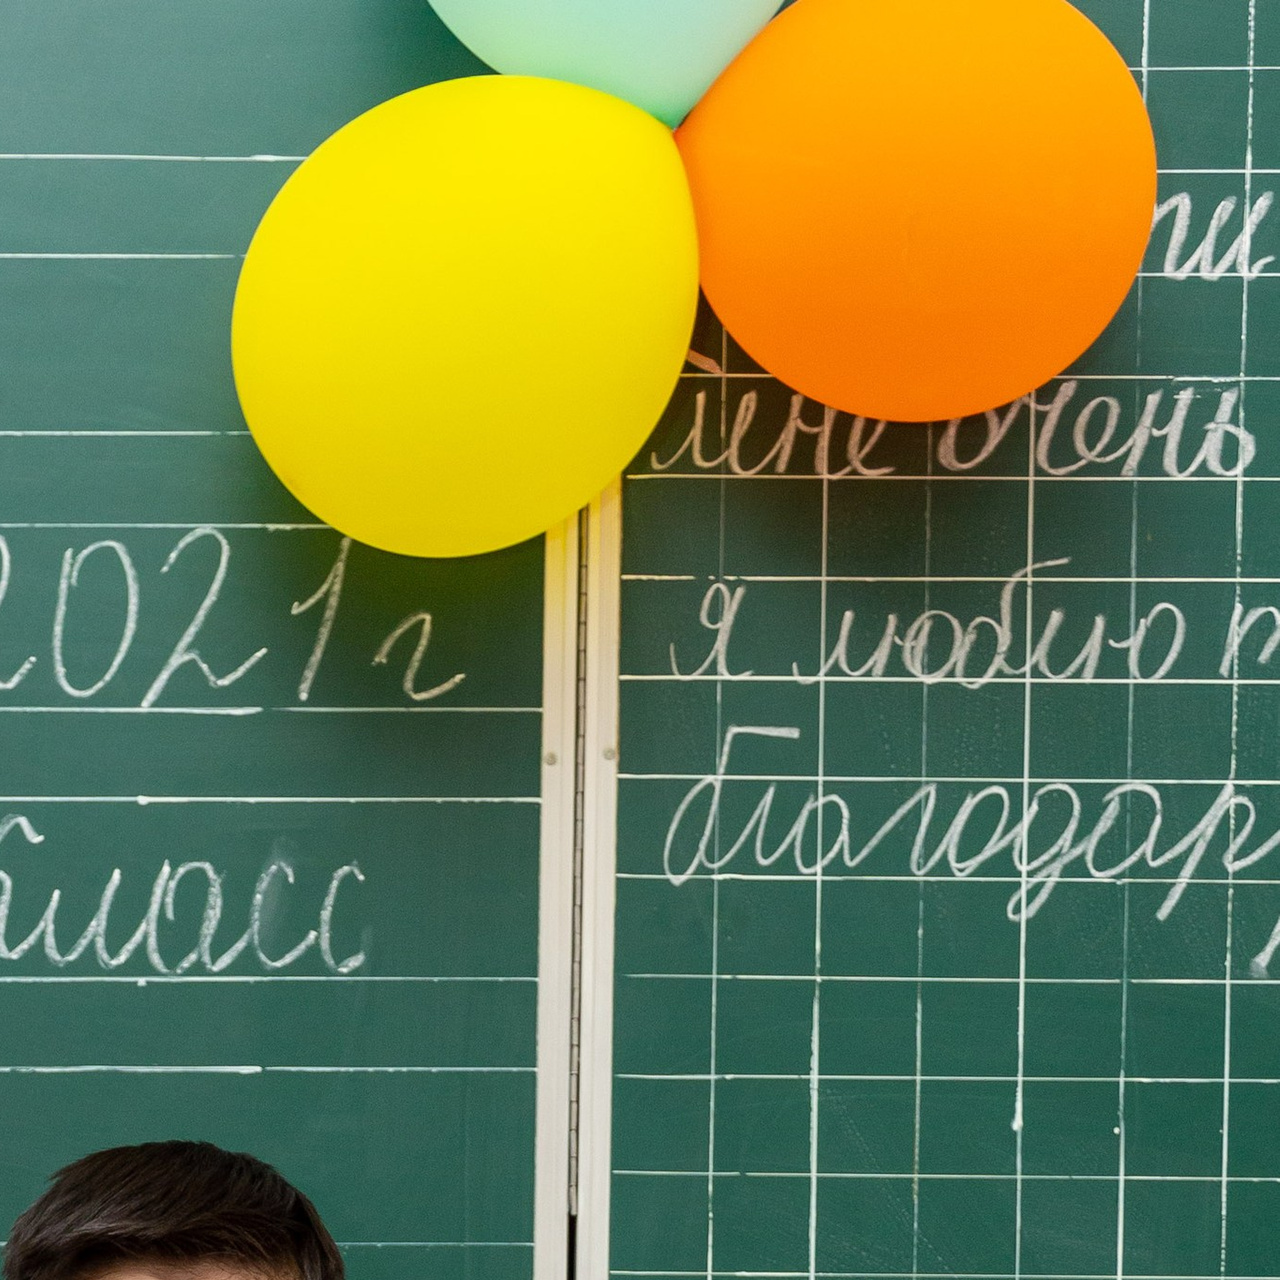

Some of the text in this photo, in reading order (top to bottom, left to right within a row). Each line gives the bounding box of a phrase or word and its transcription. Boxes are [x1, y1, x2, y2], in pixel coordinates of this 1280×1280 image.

[936, 380, 1258, 478] очень
[792, 556, 1187, 690] люблю
[663, 724, 1280, 921] благодар
